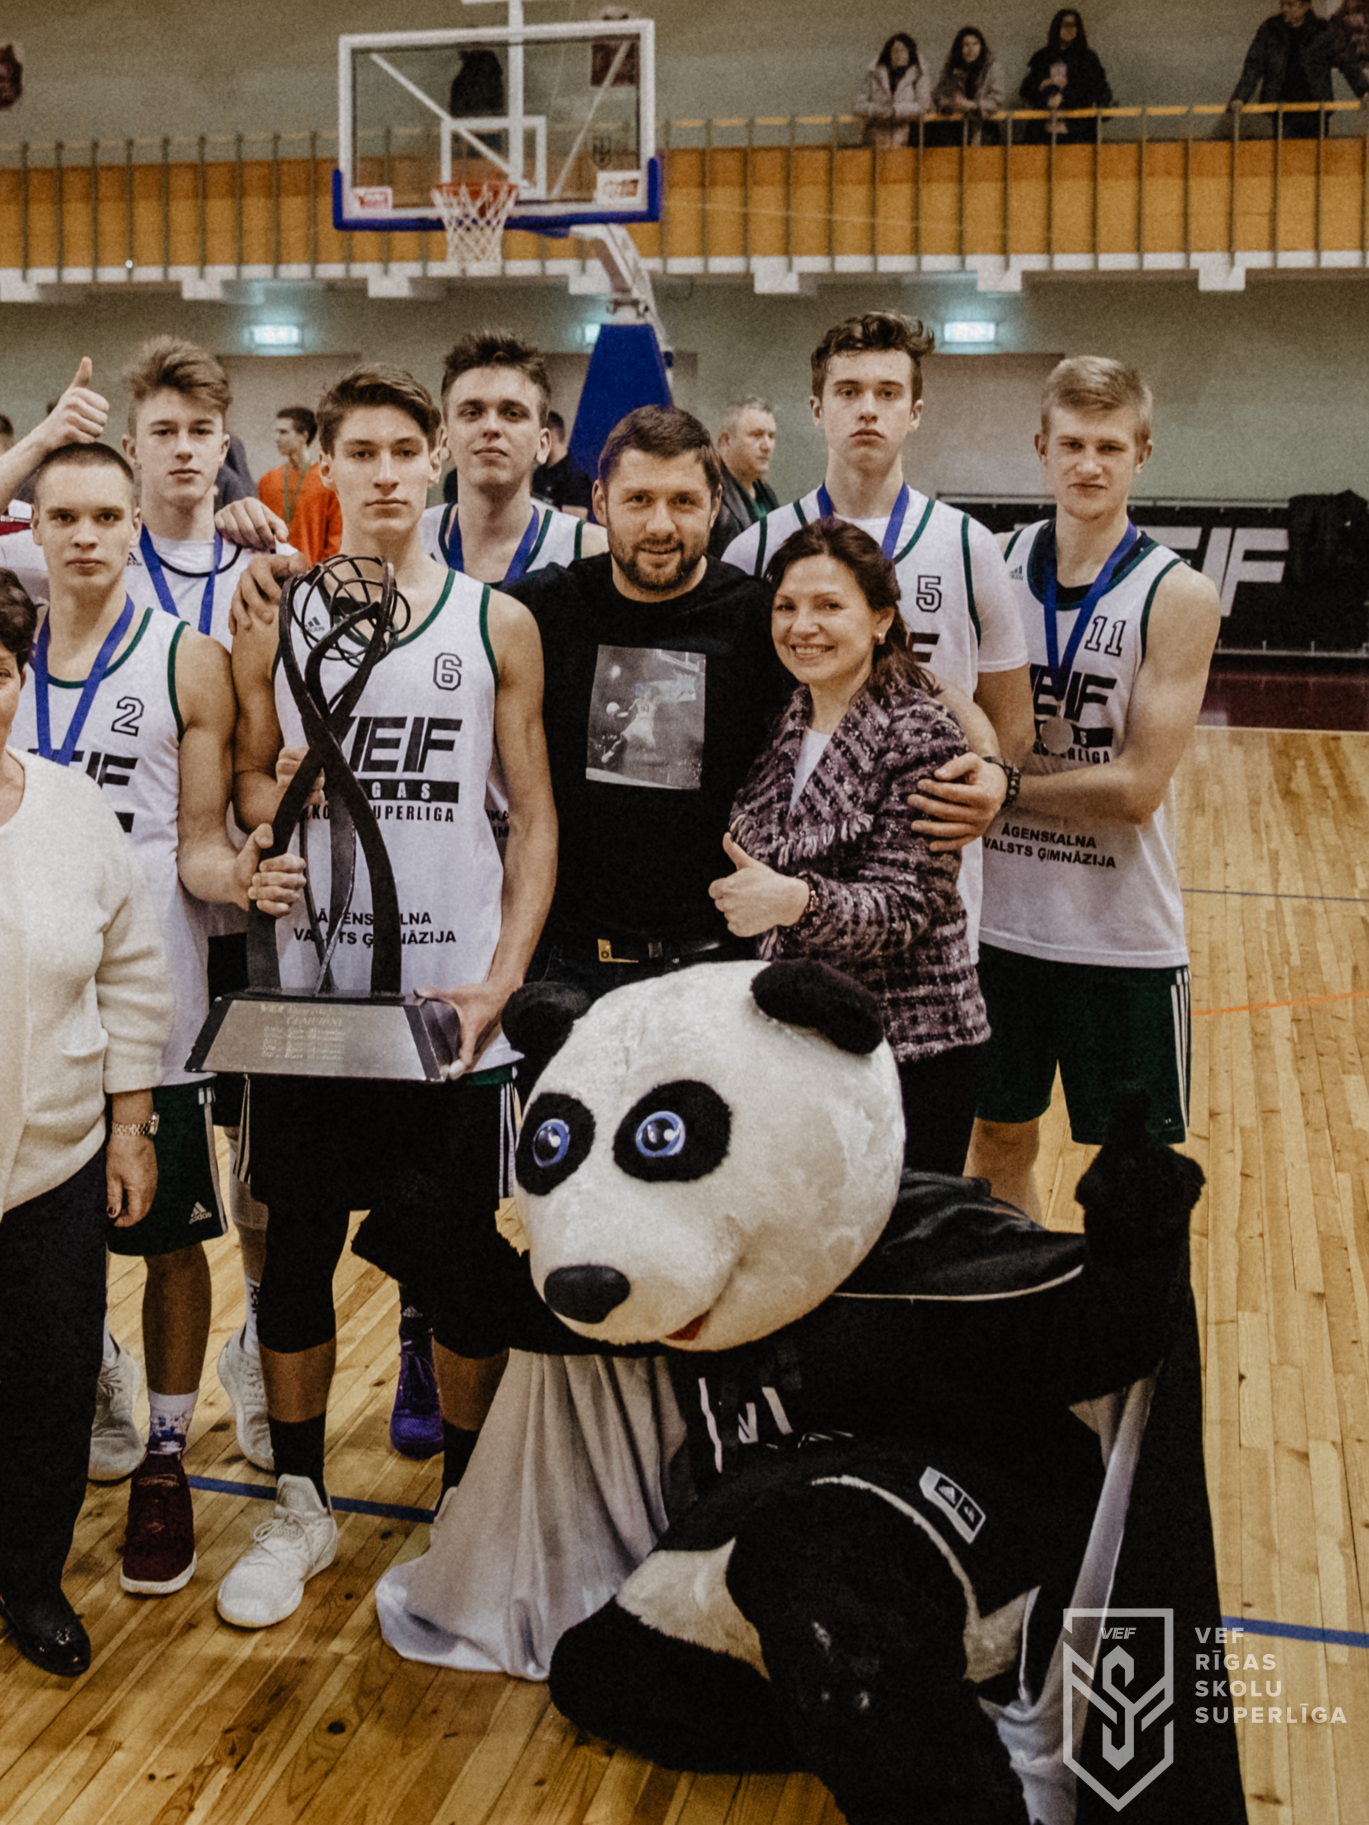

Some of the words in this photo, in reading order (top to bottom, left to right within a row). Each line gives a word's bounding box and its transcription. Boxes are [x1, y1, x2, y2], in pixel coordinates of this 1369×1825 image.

[916, 575, 942, 613] 5
[1084, 615, 1126, 657] 11
[433, 652, 462, 691] 6
[111, 696, 144, 737] 2
[375, 806, 455, 823] UPERLIGA
